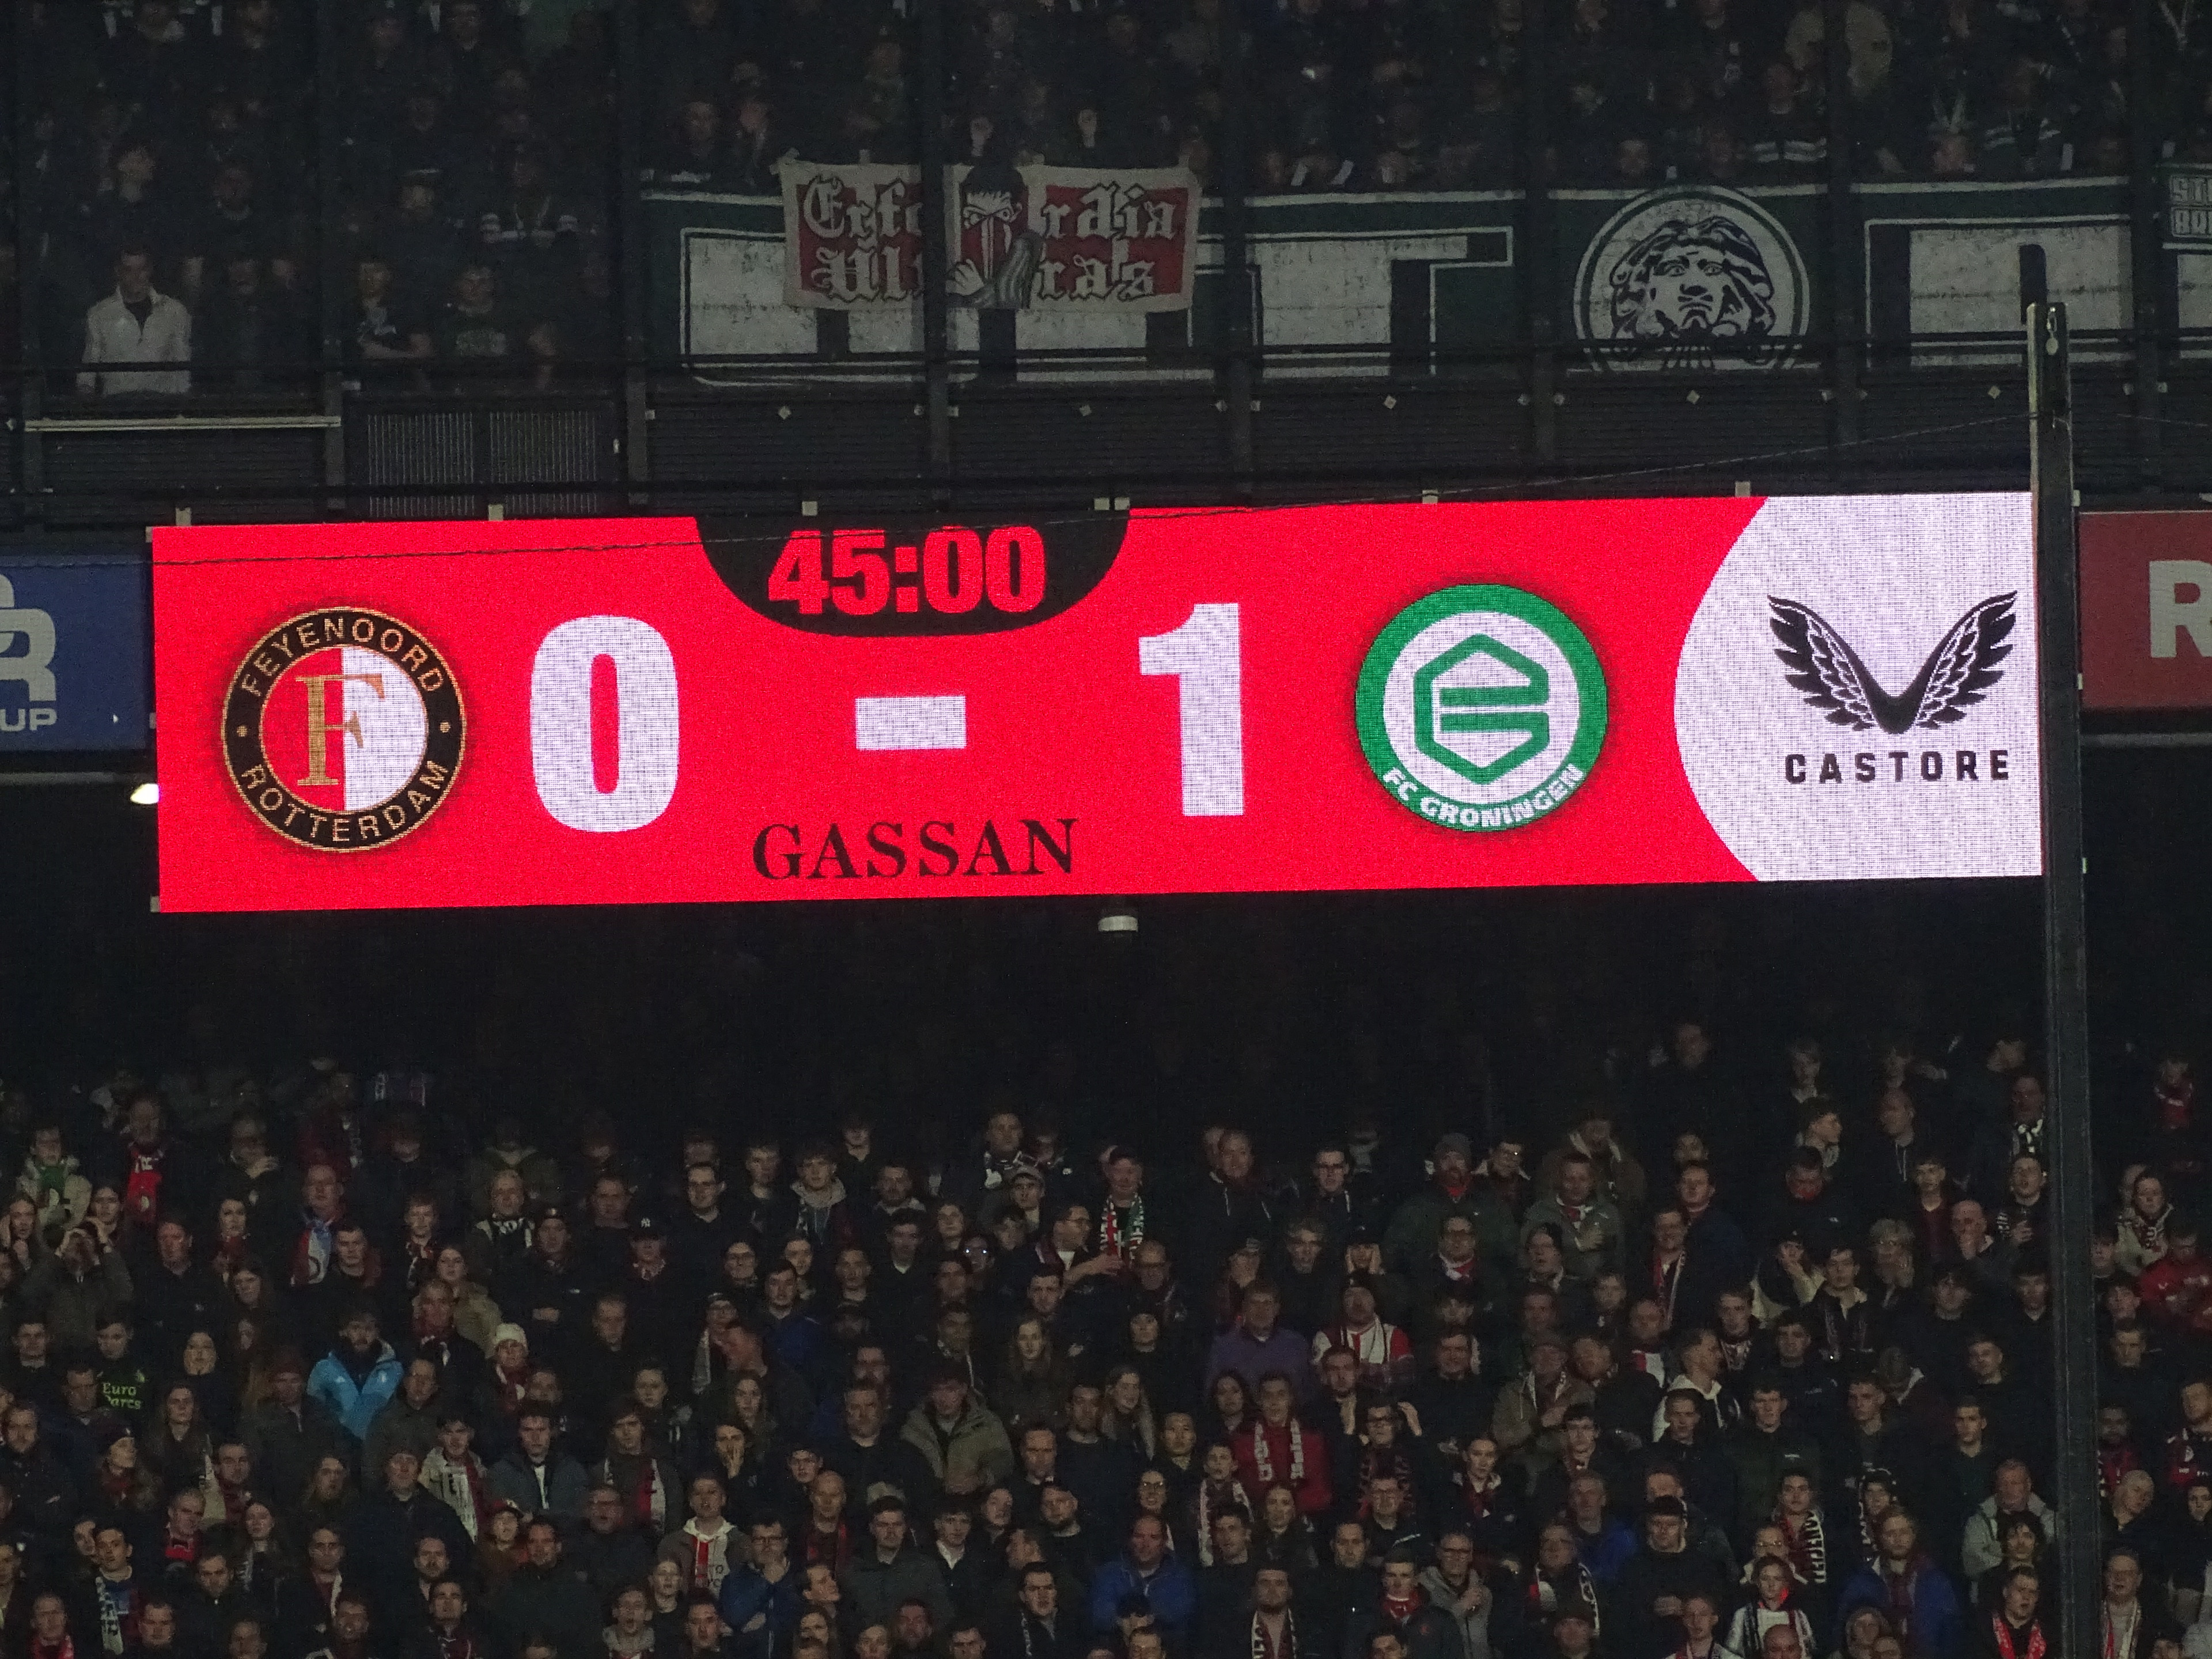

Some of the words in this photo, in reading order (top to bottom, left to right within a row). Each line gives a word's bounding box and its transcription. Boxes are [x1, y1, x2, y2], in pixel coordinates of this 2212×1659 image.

[768, 525, 1046, 616] 45:00
[241, 618, 444, 697] FEYENOORD
[530, 615, 679, 832] 0
[1139, 603, 1244, 816] 1
[241, 760, 449, 842] ROTTERDAM
[1382, 767, 1419, 801] FC
[1419, 763, 1584, 827] GRONINGEN
[1786, 749, 2009, 784] CASTORE
[752, 818, 1077, 880] GASSAN
[103, 1382, 137, 1396] Euro
